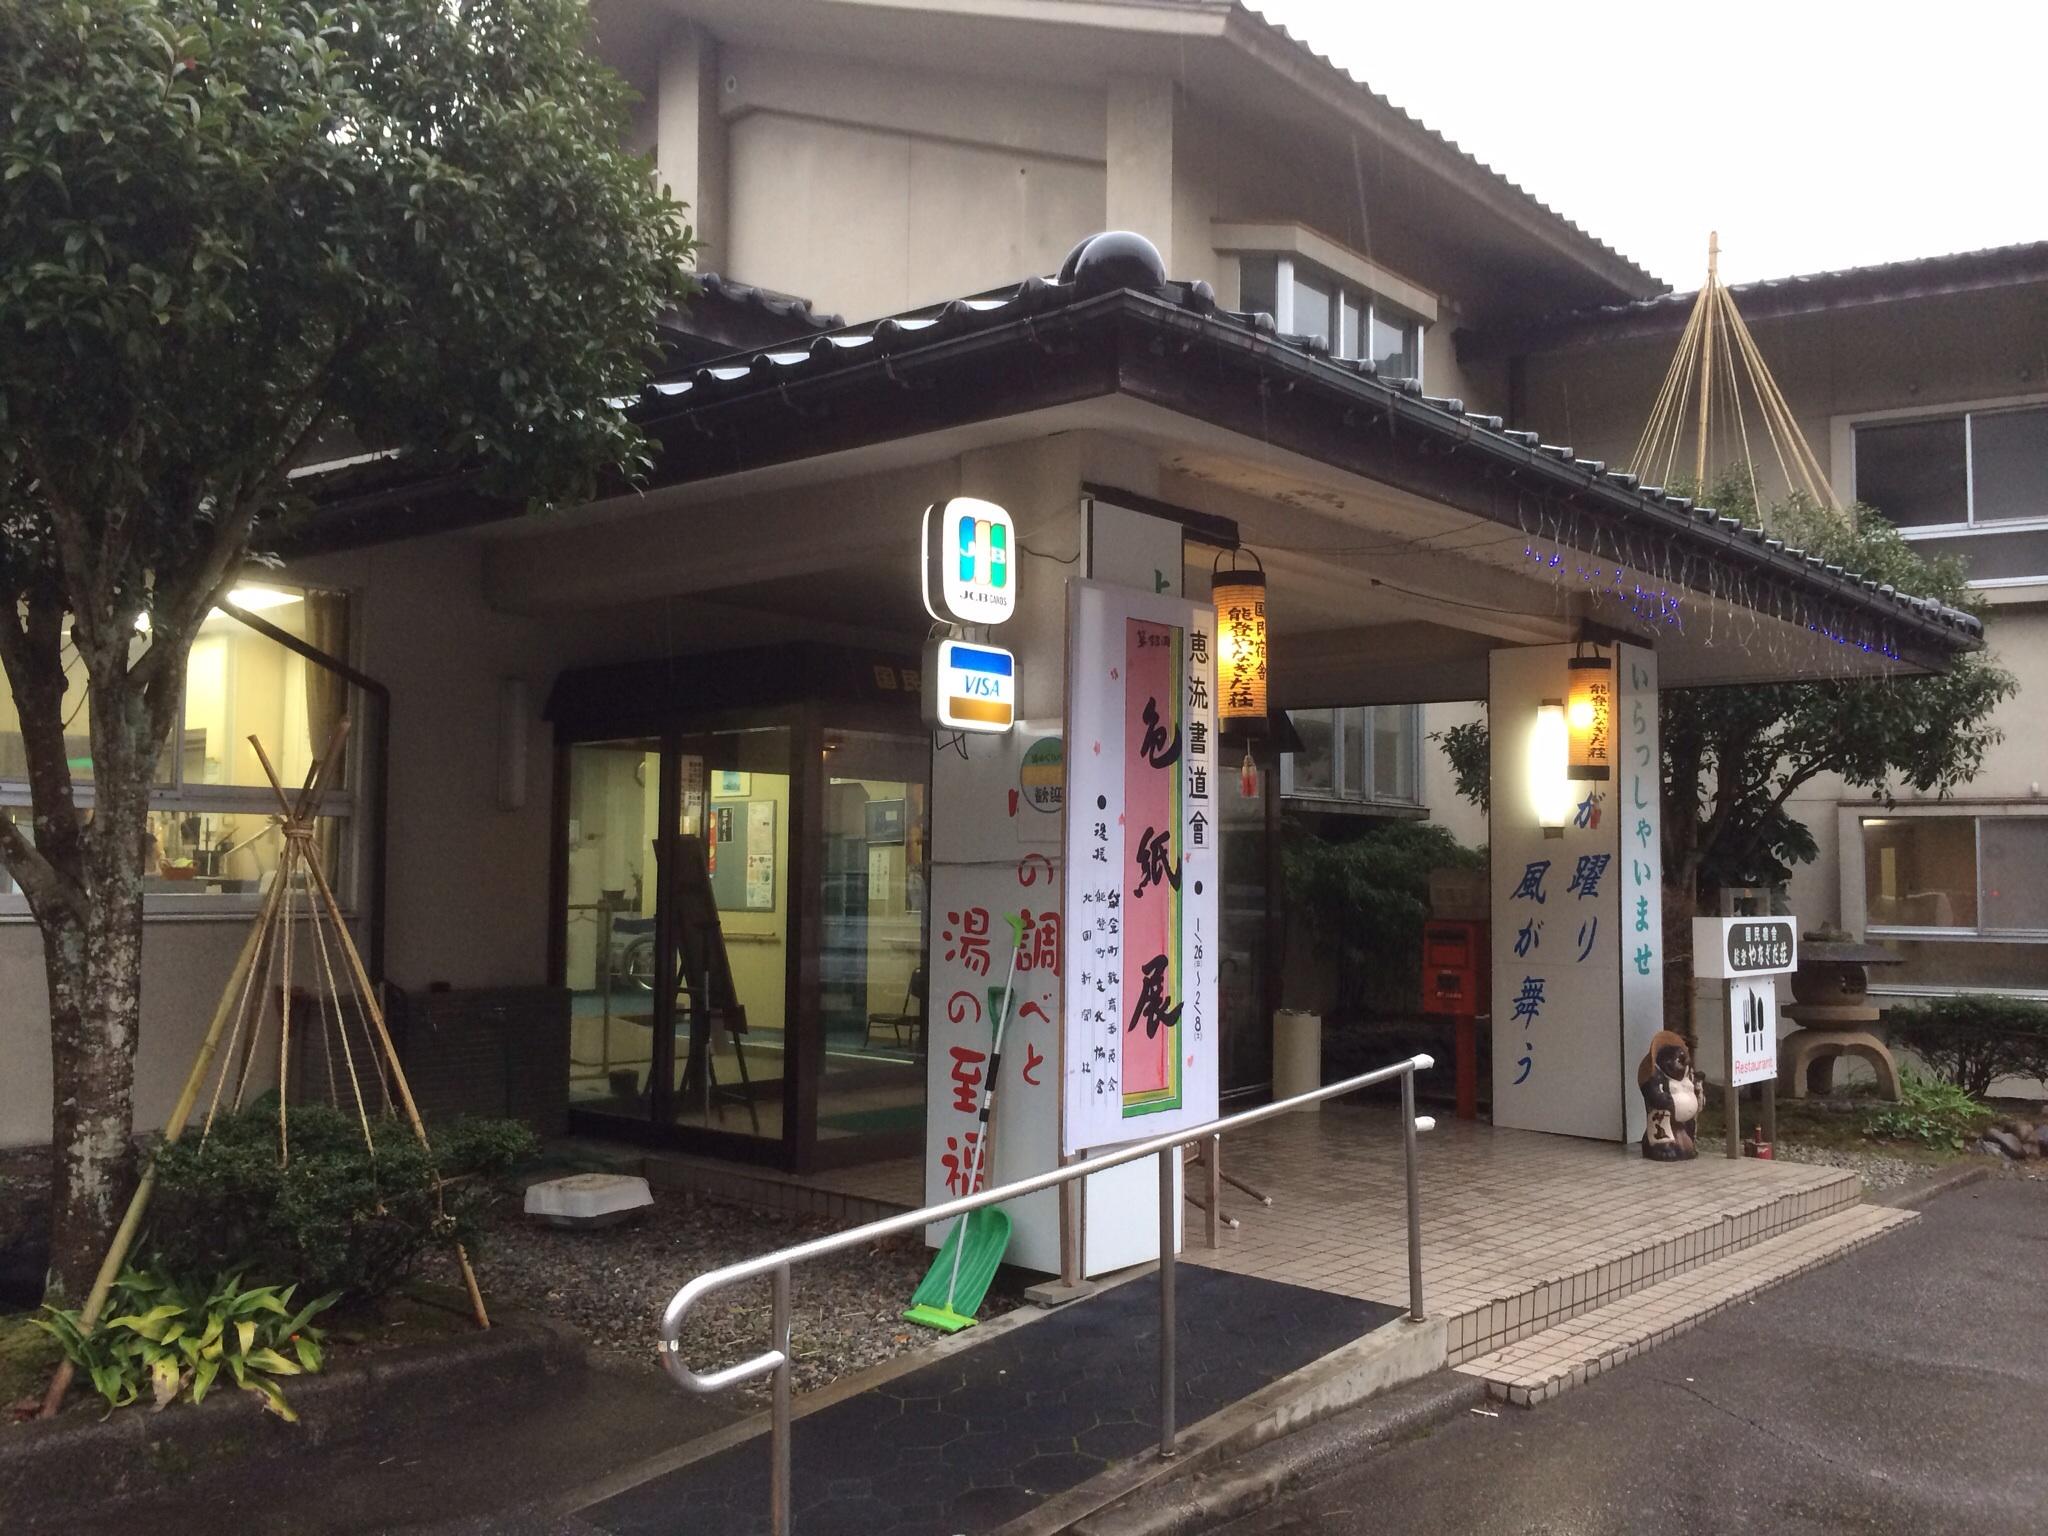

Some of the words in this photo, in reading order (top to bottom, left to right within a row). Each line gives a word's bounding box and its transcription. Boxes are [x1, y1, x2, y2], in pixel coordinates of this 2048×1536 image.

[965, 675, 999, 697] VISA
[1189, 630, 1209, 845] 恵流書道會
[1228, 607, 1254, 708] 能登やなぎだ荘
[1128, 696, 1184, 1039] 色紙展
[1632, 662, 1652, 976] いらっしゃいませ
[1510, 860, 1551, 1084] 風が舞う
[1735, 1057, 1773, 1074] Restaurant
